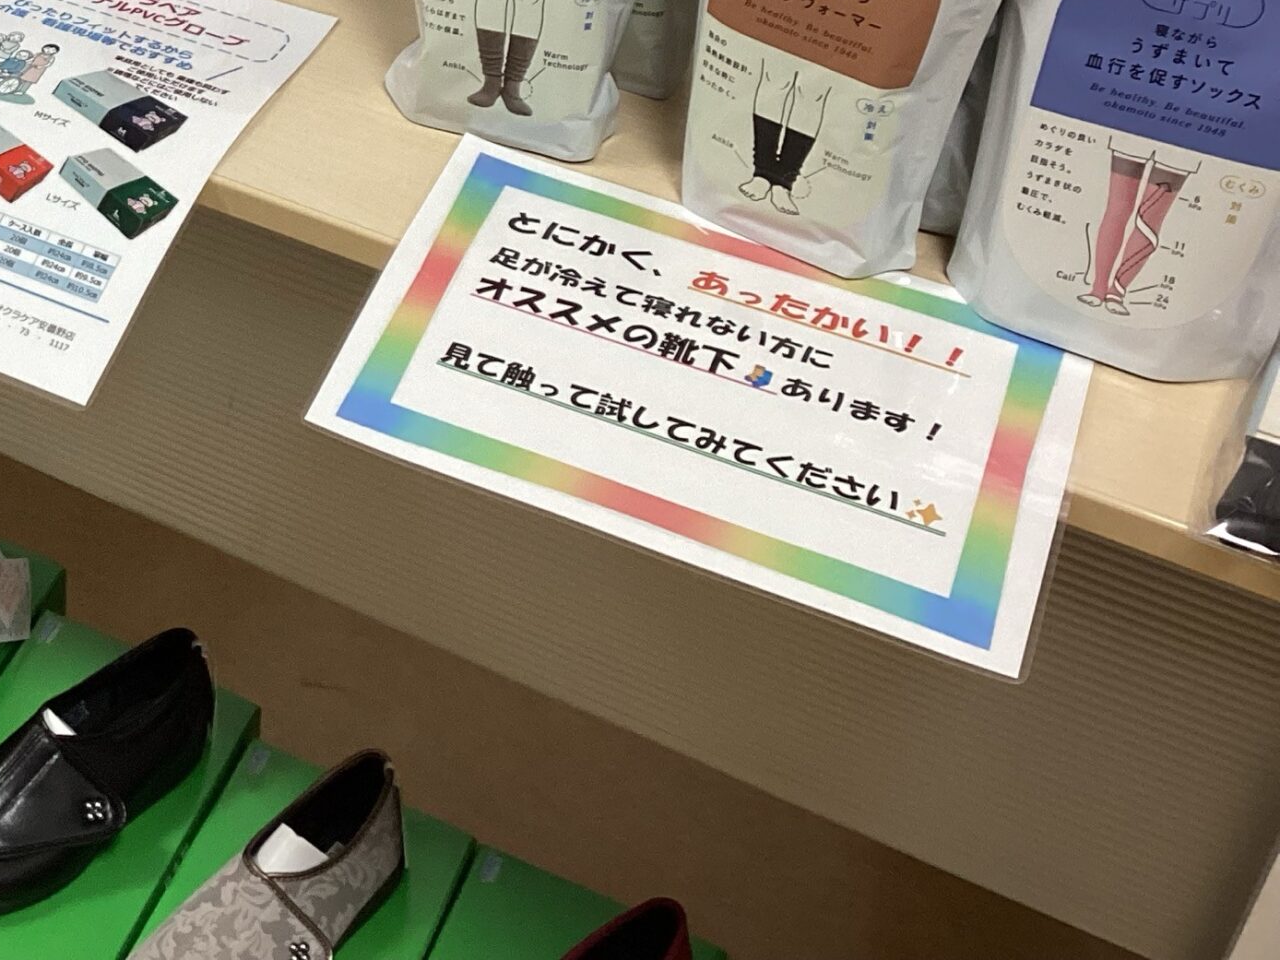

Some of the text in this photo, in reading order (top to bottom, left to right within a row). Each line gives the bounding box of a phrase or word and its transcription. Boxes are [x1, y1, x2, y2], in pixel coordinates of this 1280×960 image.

[1155, 23, 1219, 49] 寝ながら
[544, 50, 569, 61] Warm
[1130, 38, 1237, 75] うずまいて
[443, 60, 466, 71] Ankle
[543, 59, 589, 72] Technology
[1085, 53, 1262, 111] 血行を促すソックス
[1089, 82, 1105, 94] Be
[1164, 100, 1181, 113] Be
[34, 111, 71, 127] Mサイズ
[1103, 98, 1157, 122] okamoto
[1160, 113, 1192, 130] since
[712, 133, 735, 149] Ankle
[1040, 123, 1096, 143] めぐりの良い
[1034, 140, 1073, 156] カラダを
[824, 150, 849, 166] Warm
[1030, 154, 1071, 174] 目指そう。
[822, 159, 873, 182] Technology
[1027, 171, 1082, 193] うずまき状の
[46, 192, 81, 211] Lサイズ
[1016, 202, 1066, 224] むくみ軽減。
[8, 220, 42, 237] ケース入数
[3, 244, 22, 257] 20個
[507, 210, 667, 280] とにかく、
[1176, 241, 1185, 250] 11
[1056, 269, 1076, 282] Calf
[1156, 294, 1169, 303] 24
[487, 246, 836, 372] 足が冷えて寝れない方に
[49, 339, 69, 351] 1117
[471, 276, 945, 442] オススメの靴下 あります！
[438, 338, 903, 513] 見て触って試してみてください
